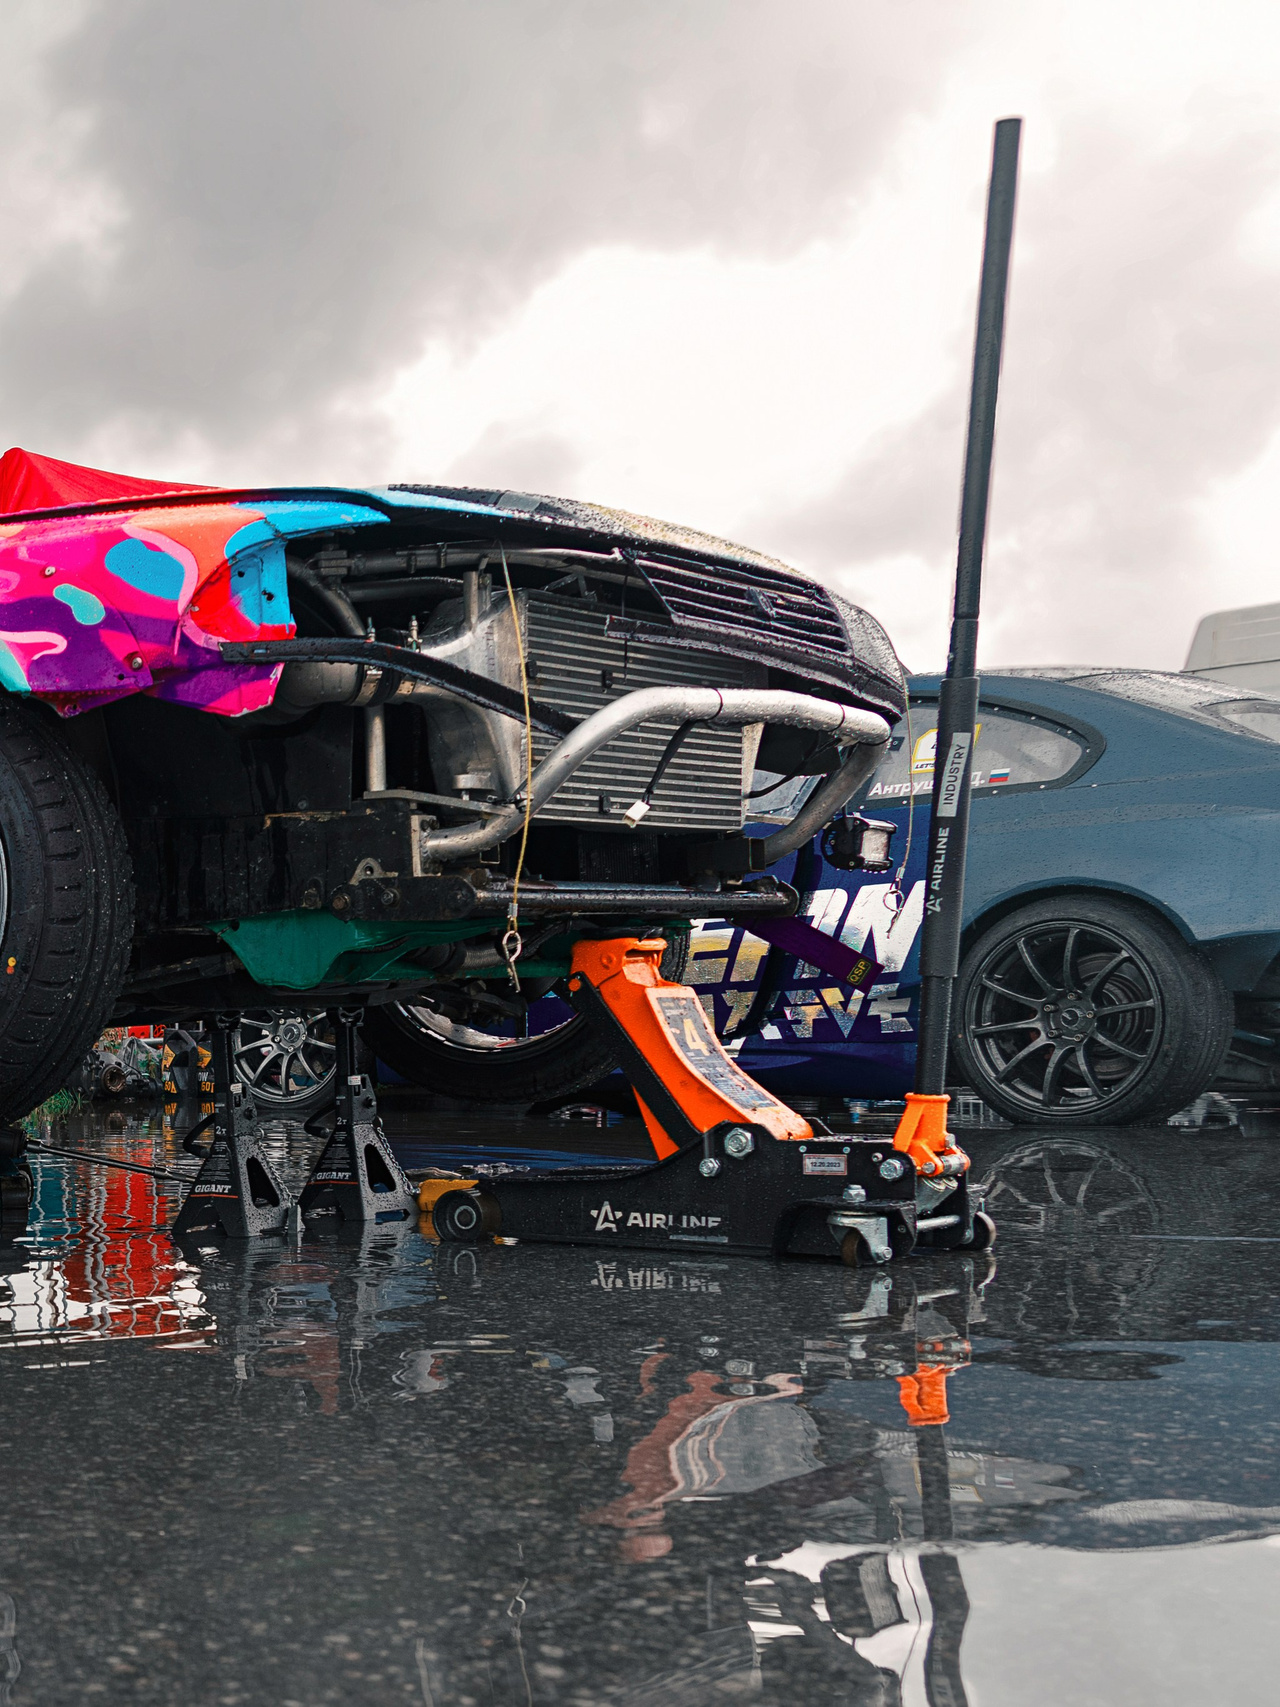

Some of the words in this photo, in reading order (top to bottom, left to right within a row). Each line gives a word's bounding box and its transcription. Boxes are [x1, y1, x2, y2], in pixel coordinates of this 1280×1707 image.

[943, 744, 965, 805] INDUSTRY
[933, 827, 950, 890] AIRLINE
[850, 961, 866, 982] QSP
[316, 1171, 352, 1180] GIGANT
[194, 1184, 232, 1193] GIGANT
